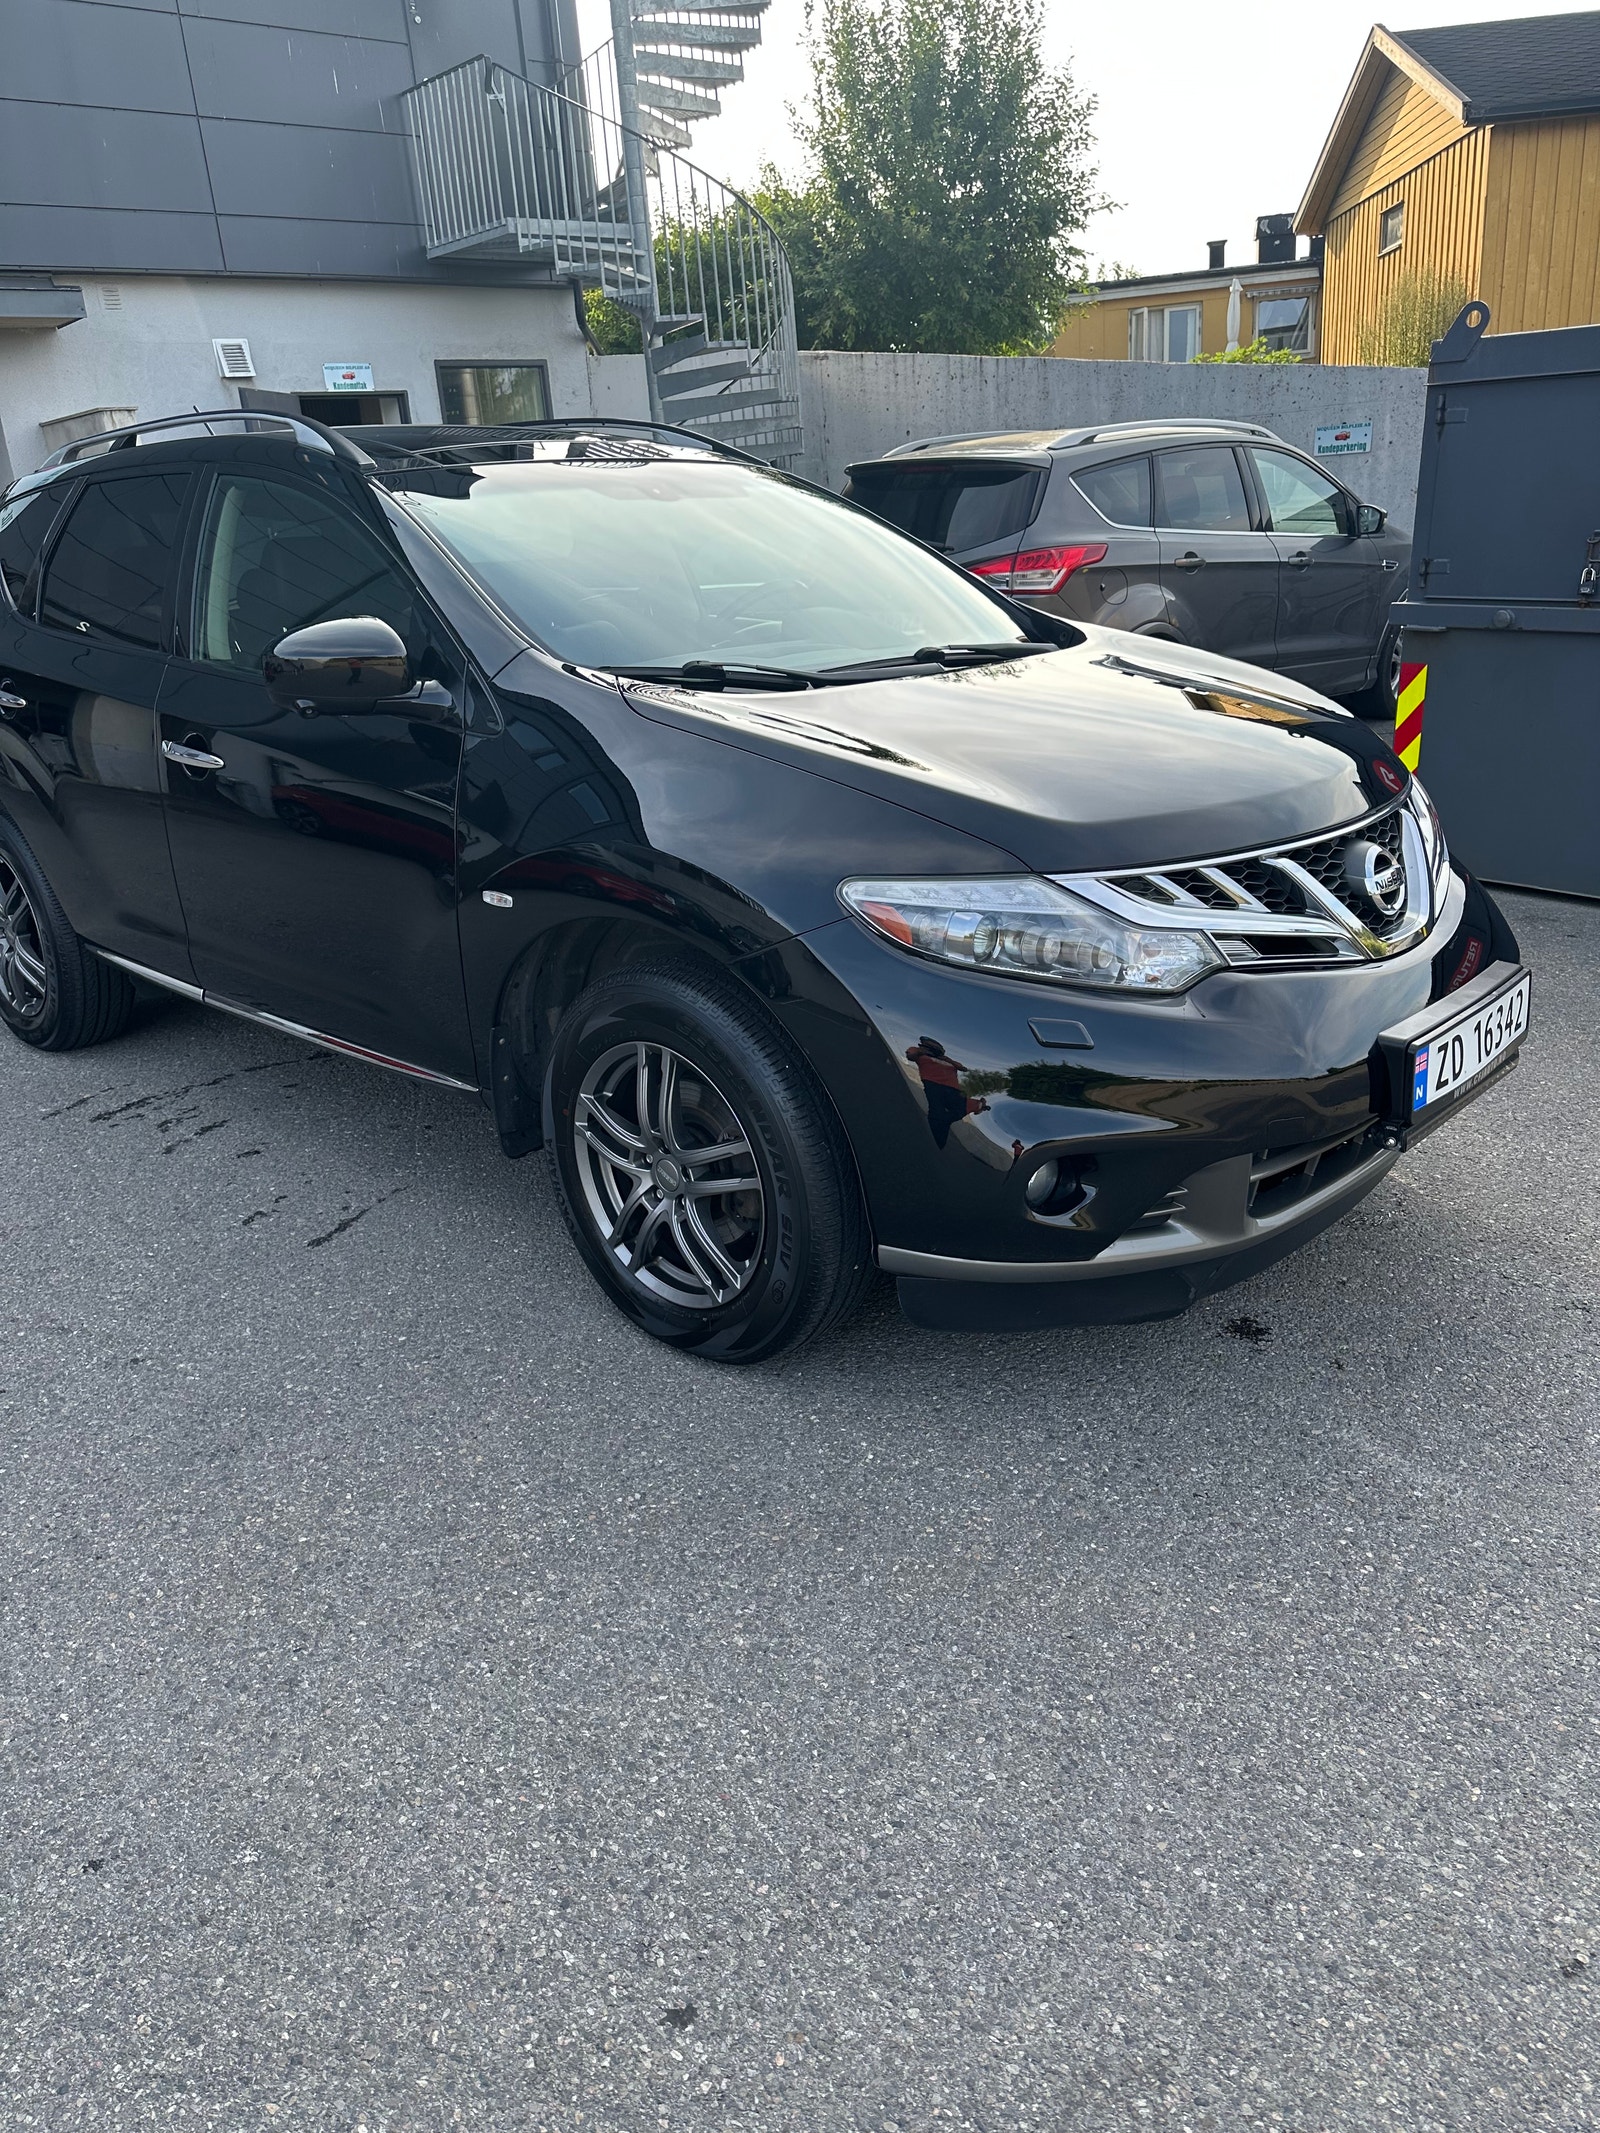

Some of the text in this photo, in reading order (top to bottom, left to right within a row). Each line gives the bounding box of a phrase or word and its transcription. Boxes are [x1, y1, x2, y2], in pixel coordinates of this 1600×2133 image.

[333, 381, 368, 390] Kundemottak
[1317, 441, 1367, 454] Kundeparkering
[1435, 988, 1524, 1092] ZD 16342
[1415, 1084, 1424, 1101] N
[779, 1212, 793, 1273] SUV
